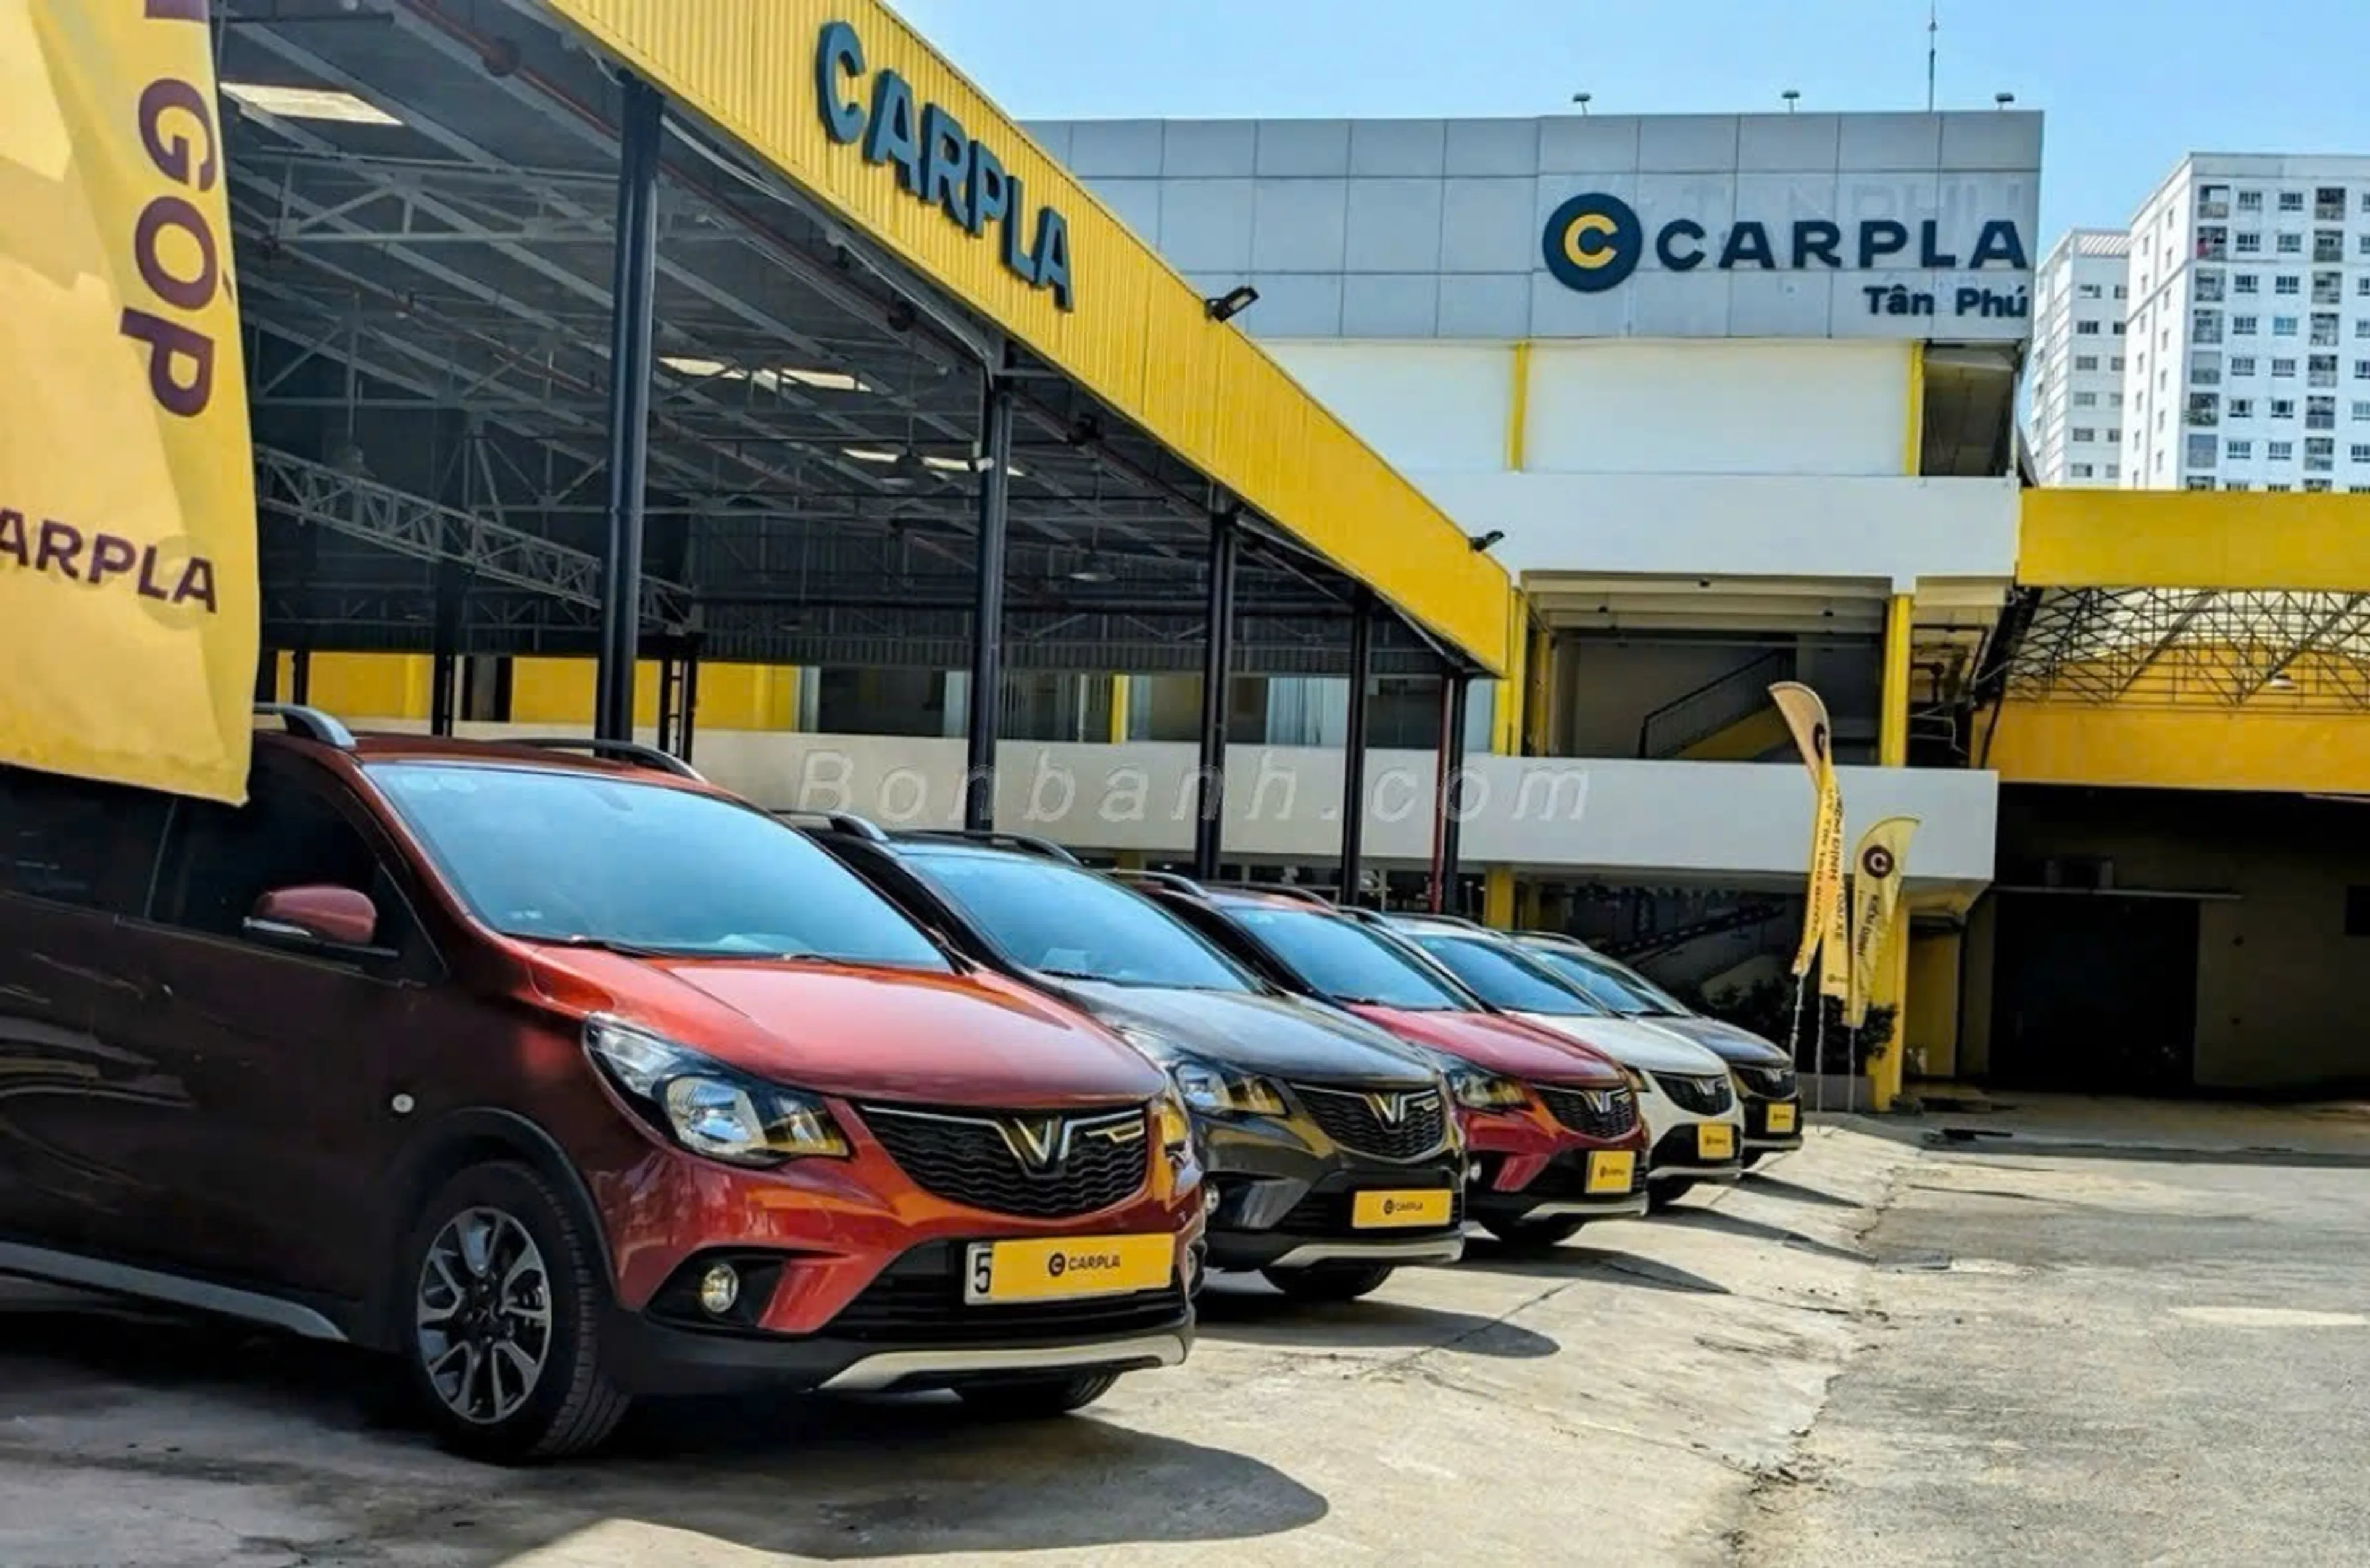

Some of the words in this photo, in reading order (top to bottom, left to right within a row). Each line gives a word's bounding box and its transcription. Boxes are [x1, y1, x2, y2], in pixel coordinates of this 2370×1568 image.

[815, 20, 1074, 313] CARPLA
[121, 78, 235, 419] GÓP
[1655, 218, 2028, 272] CARPLA
[1863, 285, 1934, 316] Tân
[1956, 286, 2028, 318] Phú
[975, 1251, 993, 1294] 5
[1068, 1255, 1121, 1271] CARPLA
